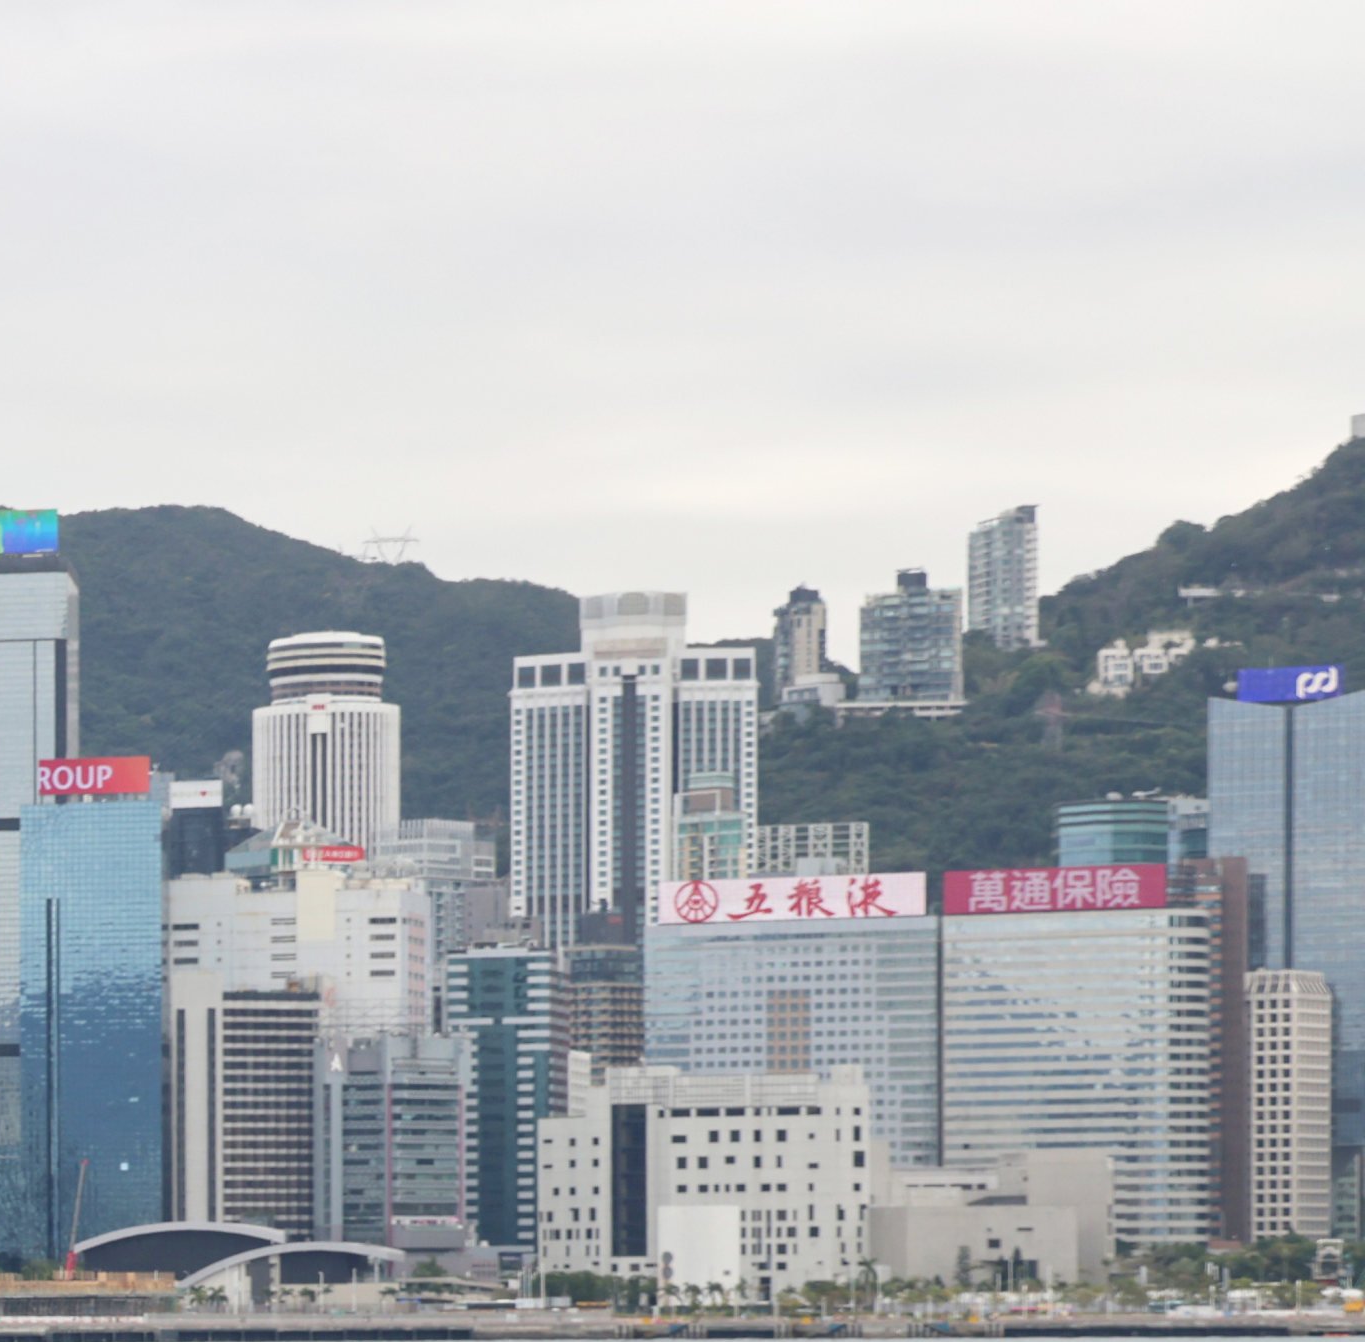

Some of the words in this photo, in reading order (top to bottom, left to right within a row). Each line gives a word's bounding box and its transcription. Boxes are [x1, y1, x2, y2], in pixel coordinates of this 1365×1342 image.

[727, 877, 897, 919] 五粮液
[968, 866, 1140, 910] 萬通保險
